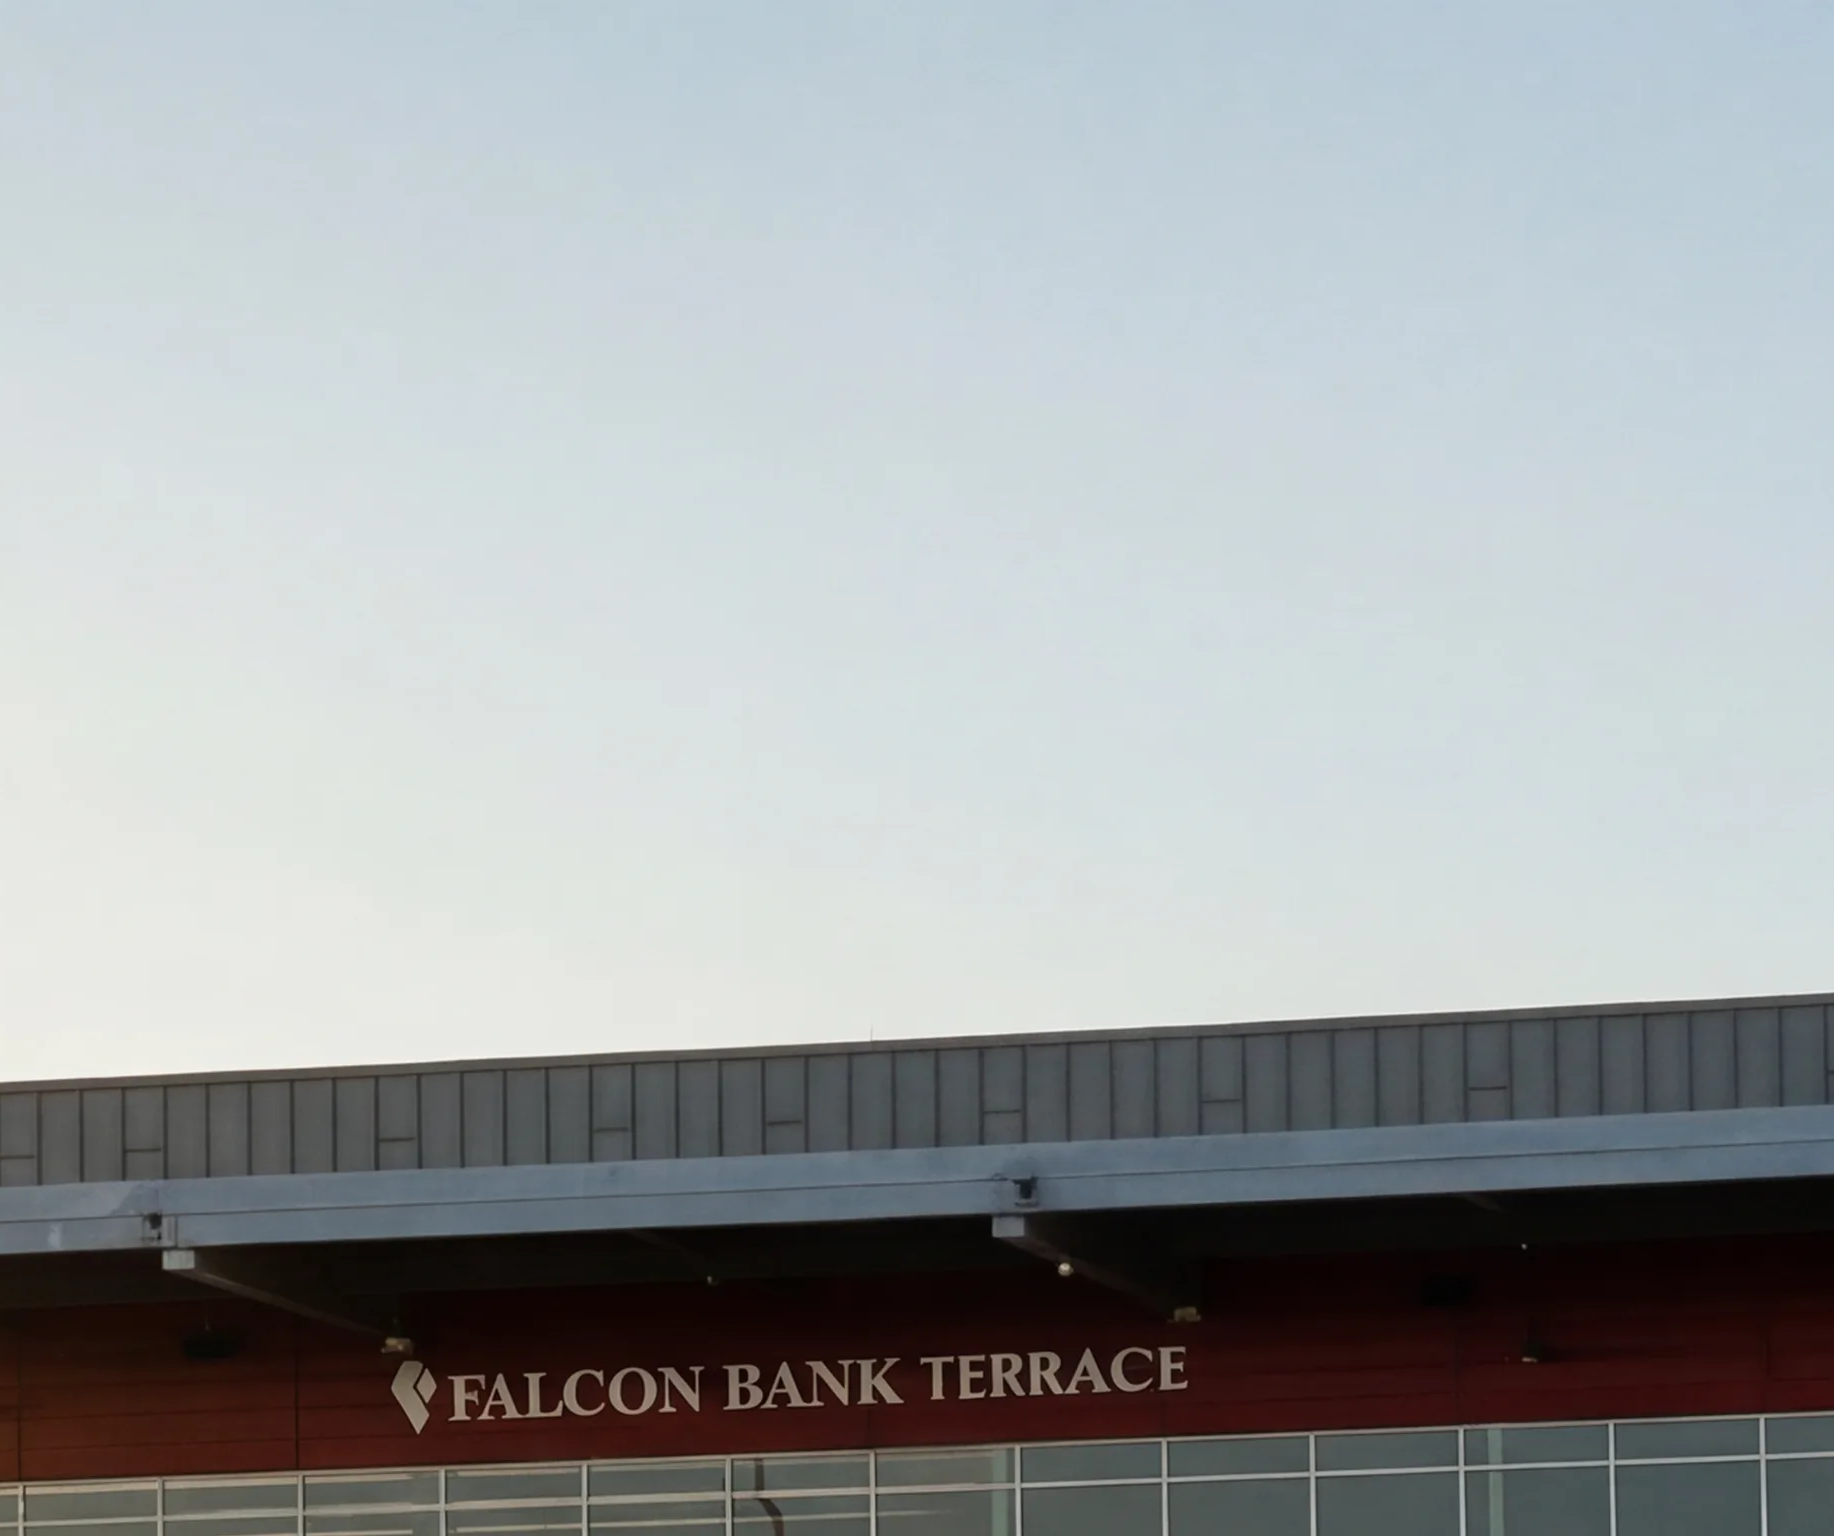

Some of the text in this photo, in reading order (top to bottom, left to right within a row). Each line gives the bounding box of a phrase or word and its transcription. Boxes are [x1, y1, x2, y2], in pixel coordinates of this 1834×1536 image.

[448, 1346, 1188, 1422] FALCON BANK TERRACE
